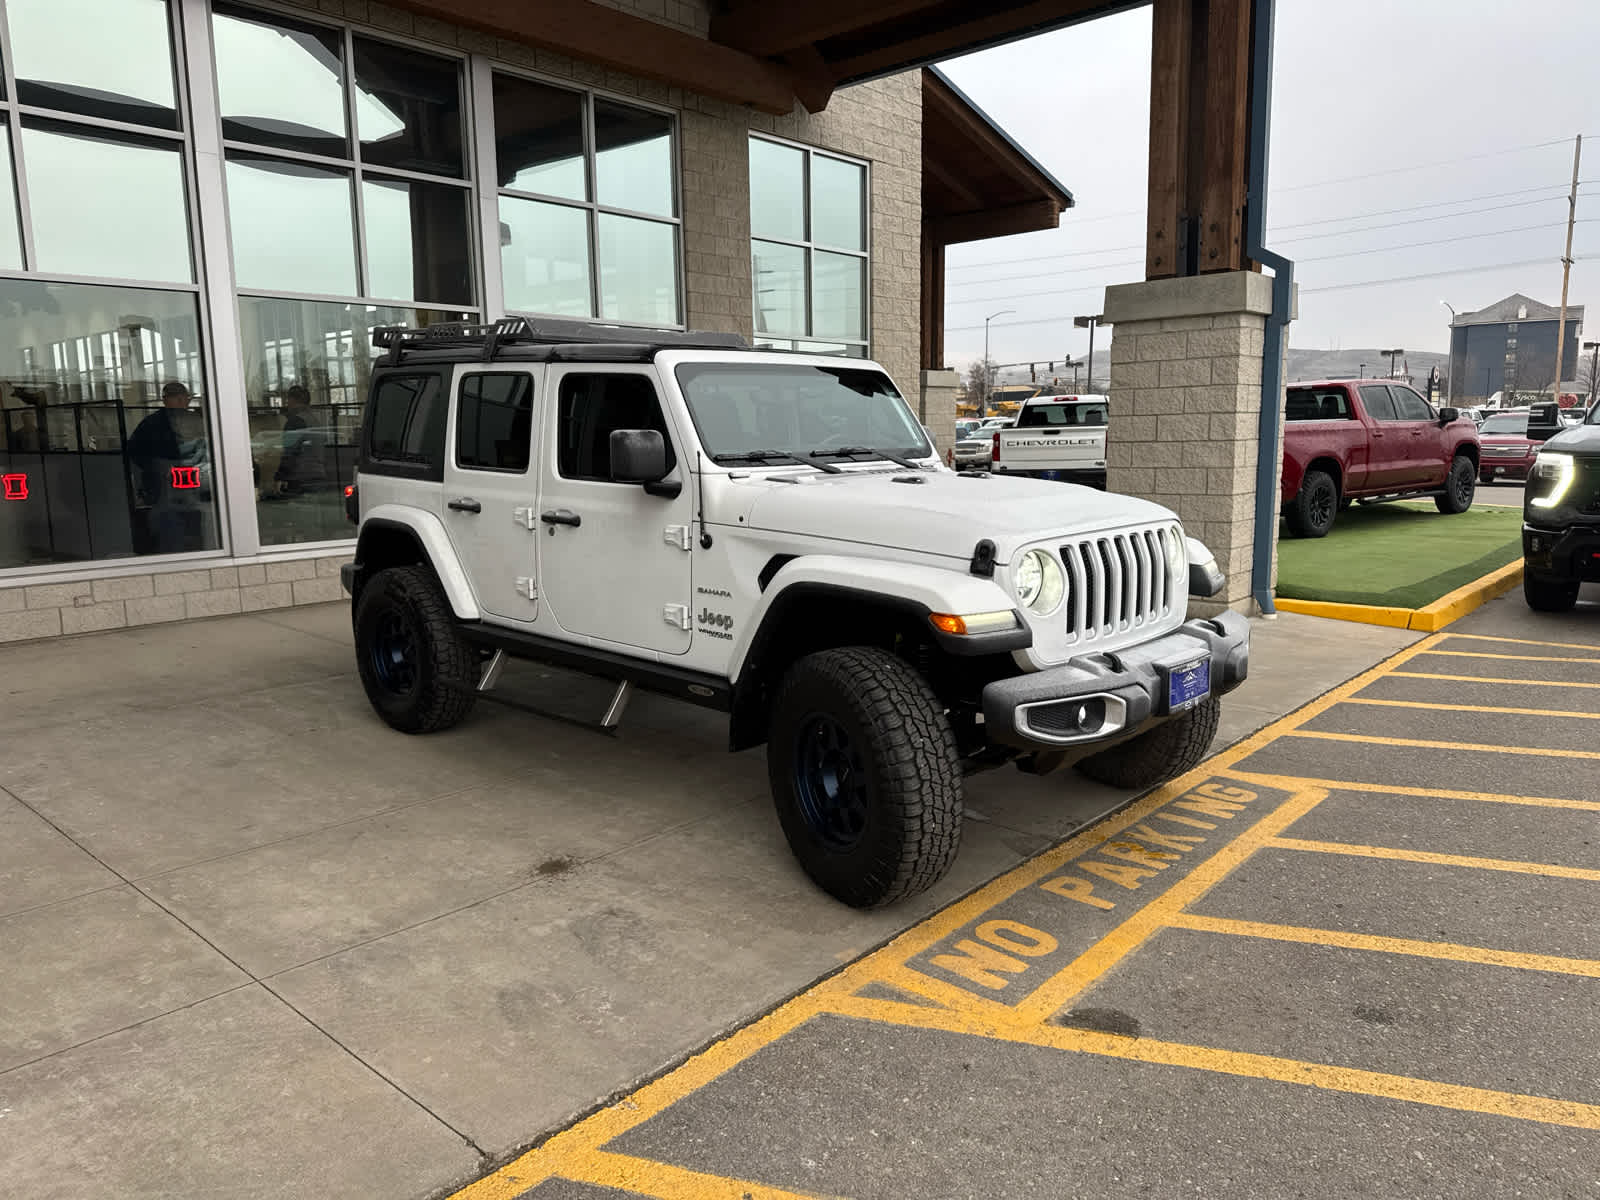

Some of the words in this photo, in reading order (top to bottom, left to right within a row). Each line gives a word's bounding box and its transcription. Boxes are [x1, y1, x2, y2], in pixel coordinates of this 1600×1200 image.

[1006, 439, 1097, 447] CHEVROLET
[697, 586, 732, 598] SAHARA
[697, 607, 733, 631] Jeep
[928, 919, 1059, 990] NO
[1039, 783, 1259, 911] PARKING
